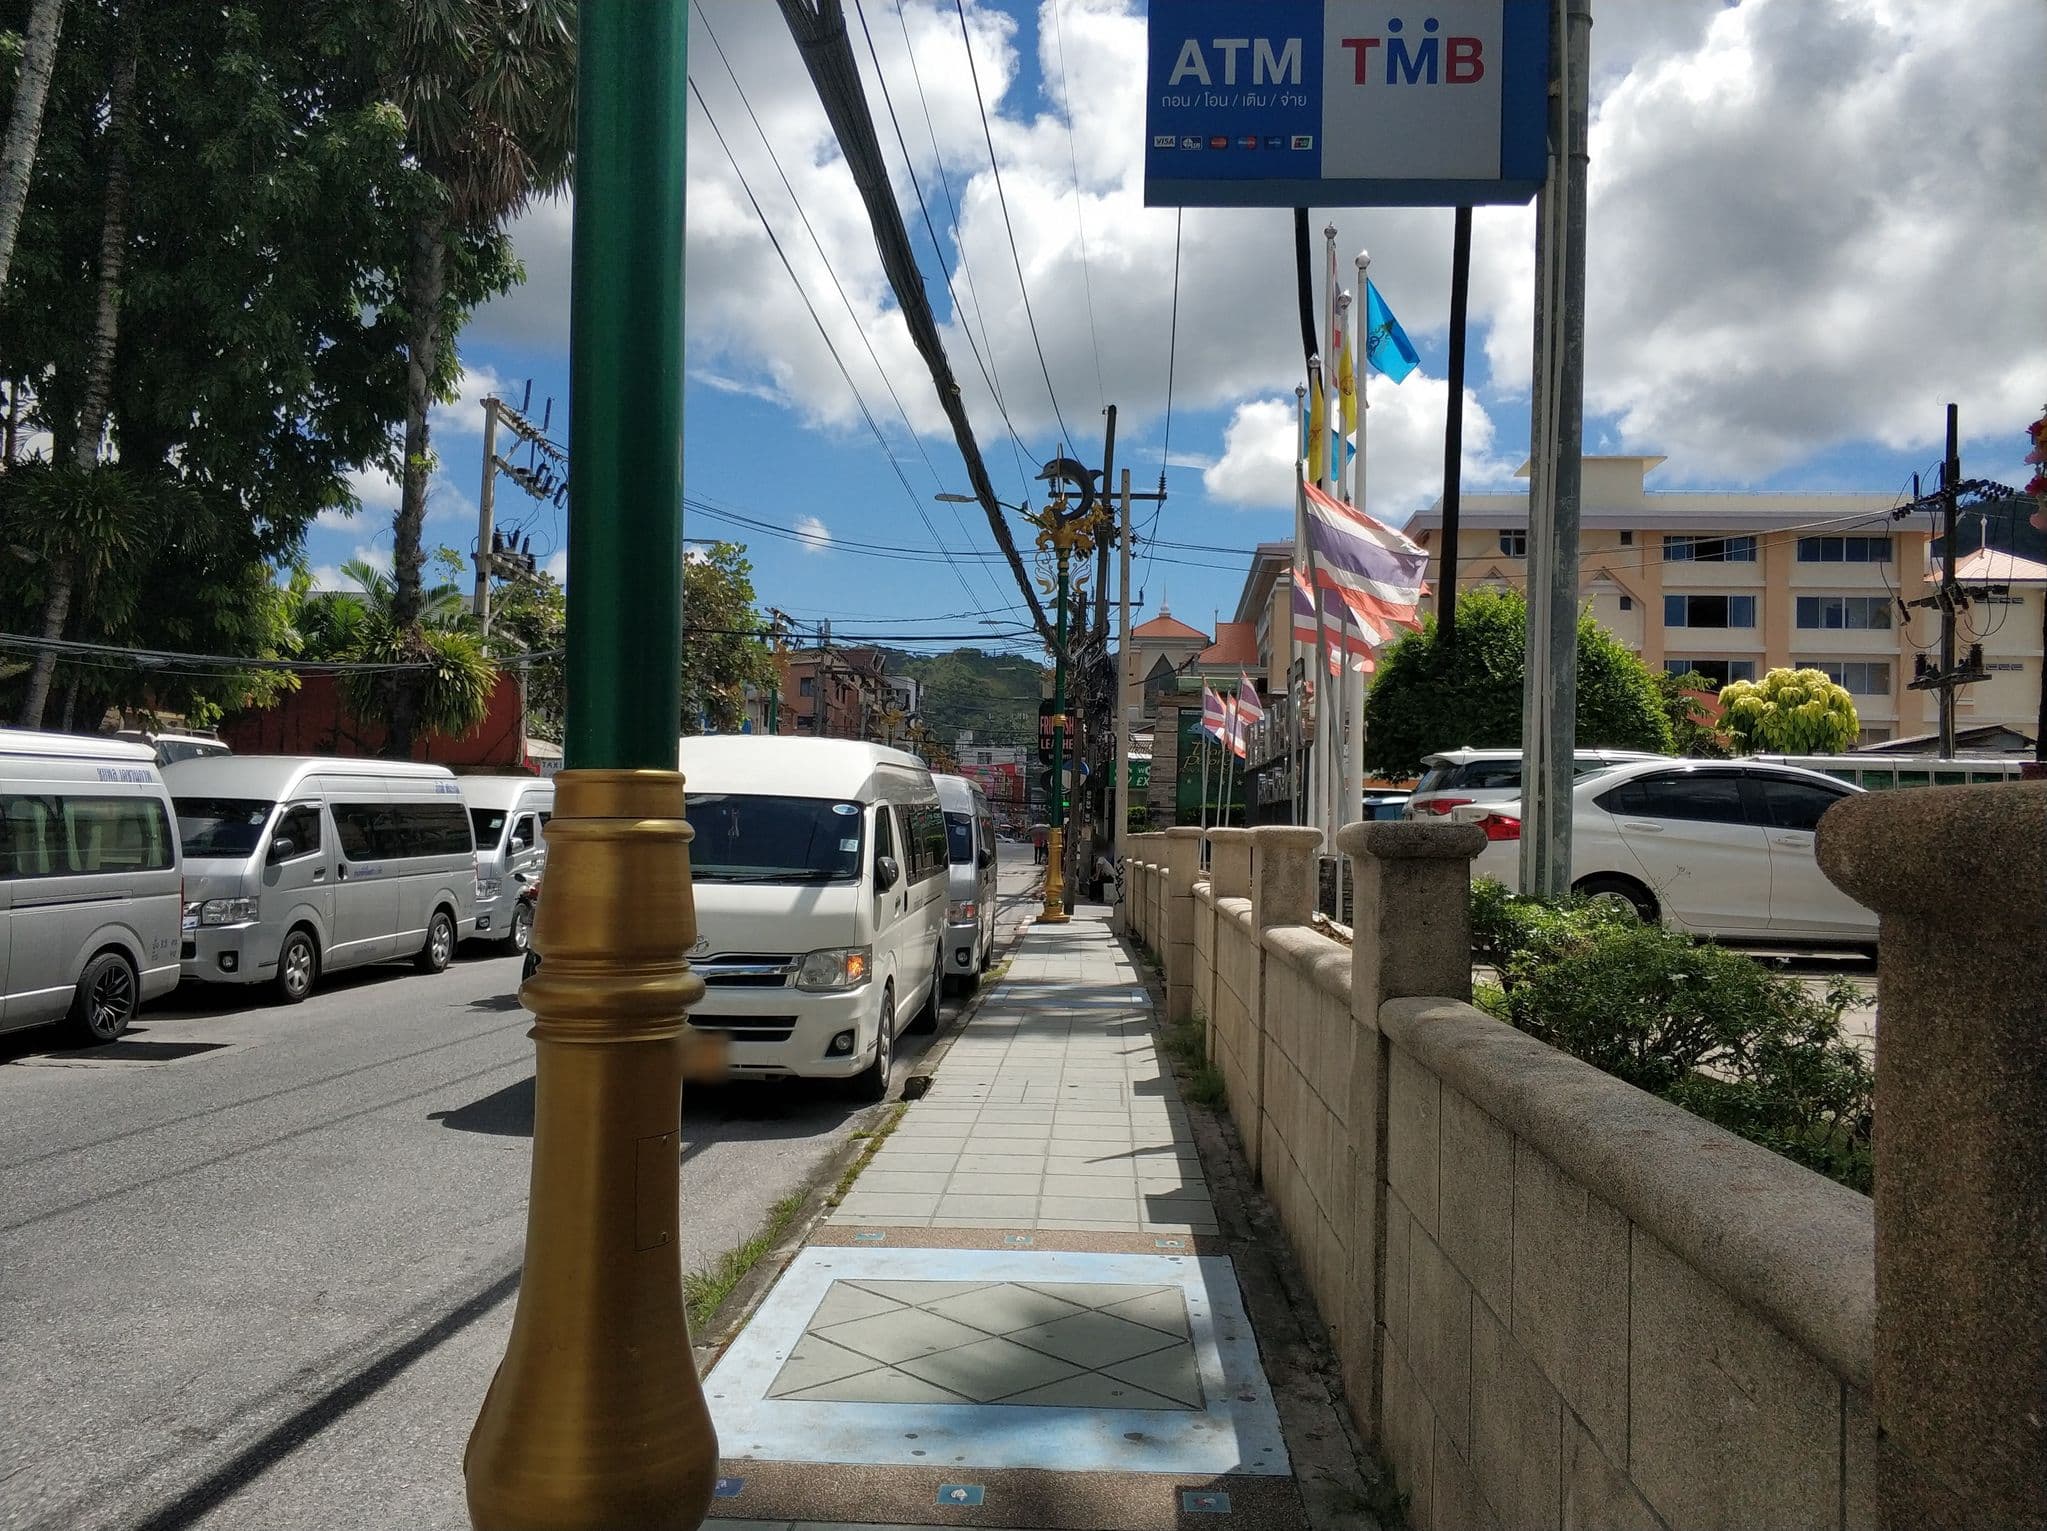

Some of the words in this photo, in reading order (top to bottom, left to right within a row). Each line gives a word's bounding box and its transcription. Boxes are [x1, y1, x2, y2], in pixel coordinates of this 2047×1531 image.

[1168, 38, 1302, 86] ATM
[1341, 36, 1485, 85] TMB
[1162, 95, 1190, 107] ถอน
[1204, 91, 1228, 107] โอน
[1242, 93, 1266, 107] เติม
[1280, 91, 1307, 107] จ่าย
[1156, 137, 1175, 145] VISA
